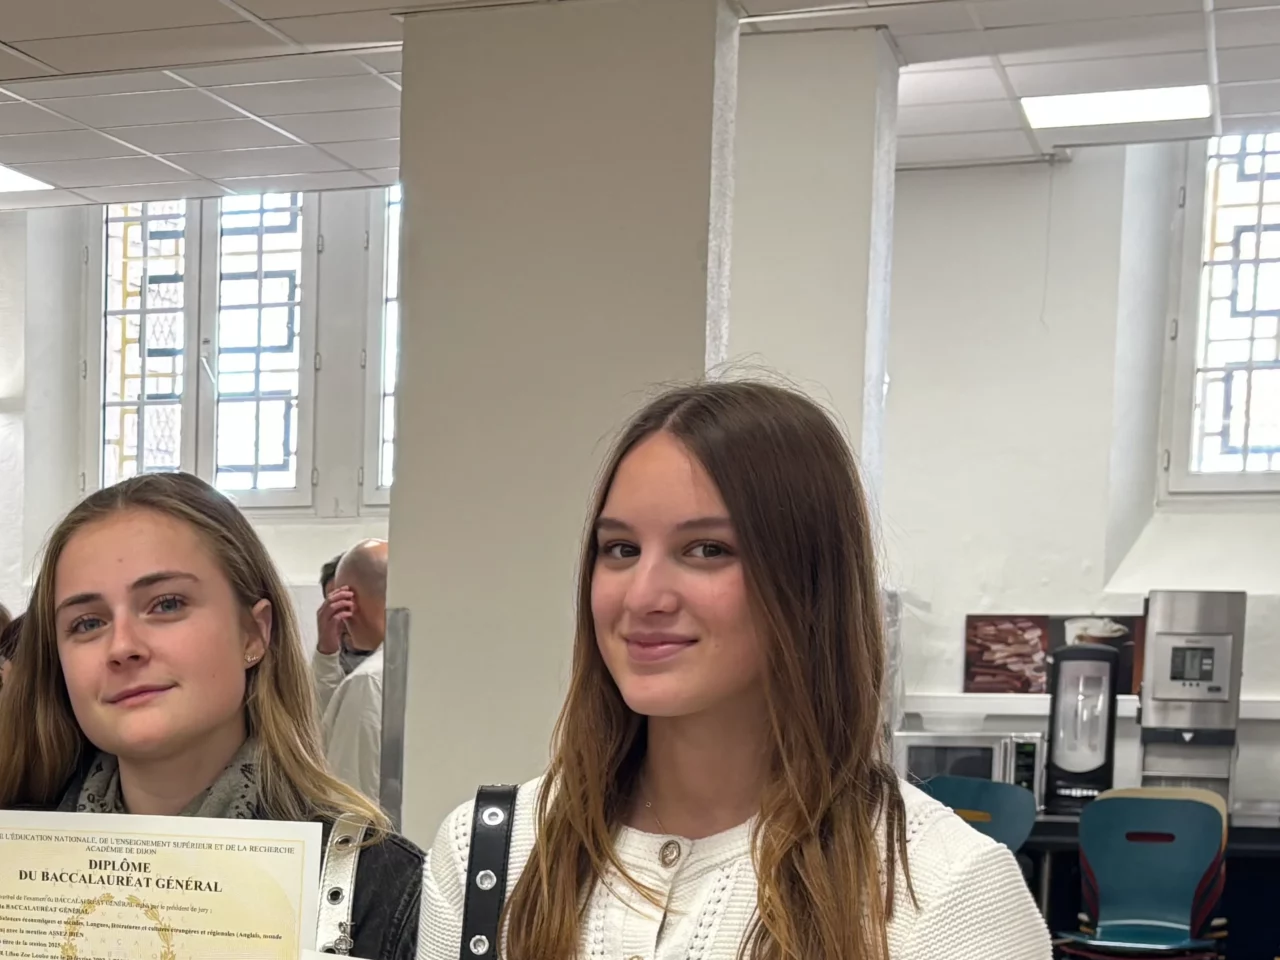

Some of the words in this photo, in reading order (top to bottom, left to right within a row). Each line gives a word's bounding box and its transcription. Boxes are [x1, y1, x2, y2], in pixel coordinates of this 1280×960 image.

[5, 832, 52, 842] L'ÉDUCATION
[99, 836, 108, 845] DE
[110, 837, 170, 848] L'ENSEIGNEMENT
[172, 840, 212, 851] SUPÉRIEUR
[214, 842, 224, 851] ET
[225, 843, 235, 852] DE
[237, 843, 247, 852] LA
[249, 844, 295, 855] RECHERCHE
[85, 844, 123, 854] ACADÉMIE
[125, 845, 134, 854] DE
[136, 846, 156, 855] DIJON
[88, 858, 151, 872] DIPLÔME
[19, 869, 36, 882] DU
[41, 871, 151, 887] BACCALAURÉAT
[155, 878, 223, 892] GÉNÉRAL
